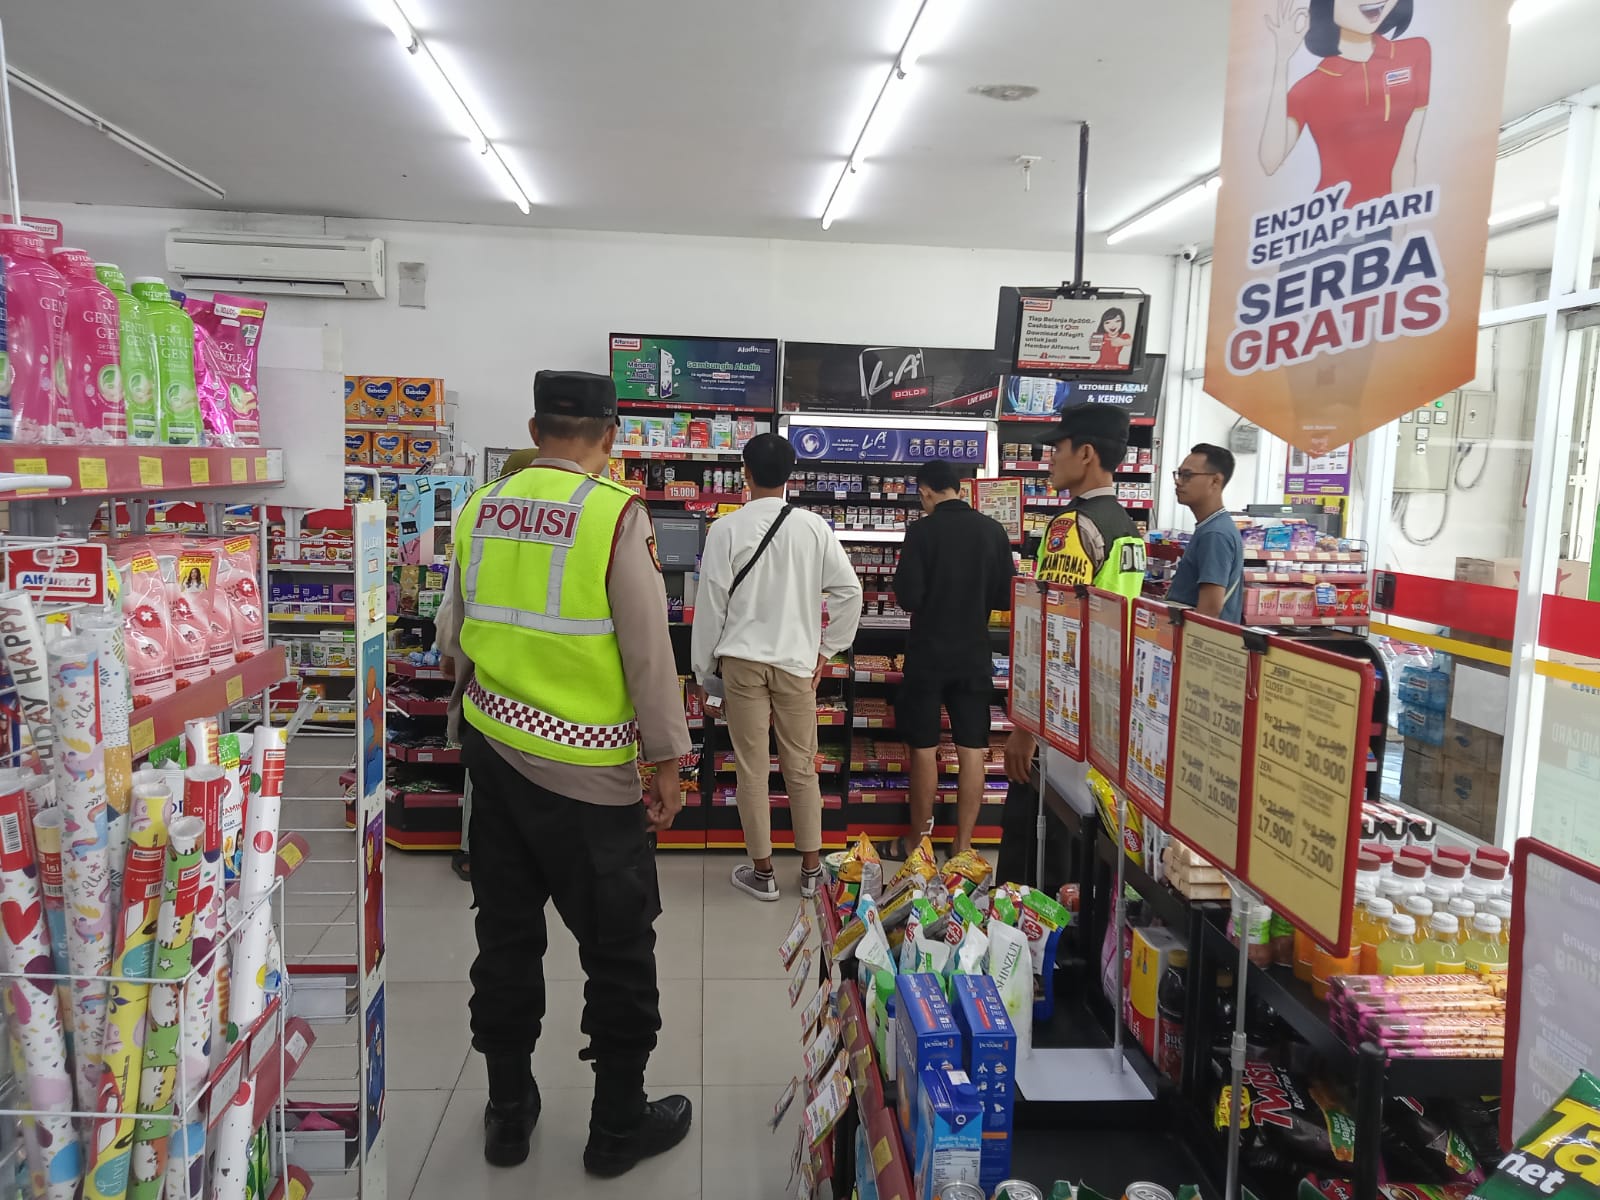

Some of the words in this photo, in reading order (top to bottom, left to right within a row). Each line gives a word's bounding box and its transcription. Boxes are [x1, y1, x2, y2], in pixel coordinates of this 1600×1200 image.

[1251, 215, 1349, 264] SETIAP
[1356, 190, 1434, 232] HARI
[1254, 188, 1346, 239] ENJOY
[1240, 236, 1437, 325] SERBA
[1230, 284, 1442, 371] GRATIS
[161, 348, 188, 360] GEN
[734, 362, 760, 372] Aladin
[895, 390, 920, 398] BOLD
[1098, 395, 1134, 404] KERING
[1114, 384, 1148, 392] BASAH
[670, 488, 696, 498] 15.000
[476, 504, 578, 538] POLISI
[22, 574, 91, 586] Alfamart
[0, 606, 42, 684] HAPPY
[1266, 679, 1284, 694] CLOSE
[1212, 711, 1242, 737] 17.500
[1262, 732, 1300, 762] 14.900
[1260, 761, 1272, 773] ZEN
[1304, 750, 1346, 784] 30.900
[1208, 784, 1237, 814] 10.900
[1258, 814, 1293, 849] 17.900
[1302, 838, 1334, 872] 7.500
[1497, 1153, 1566, 1194] net
